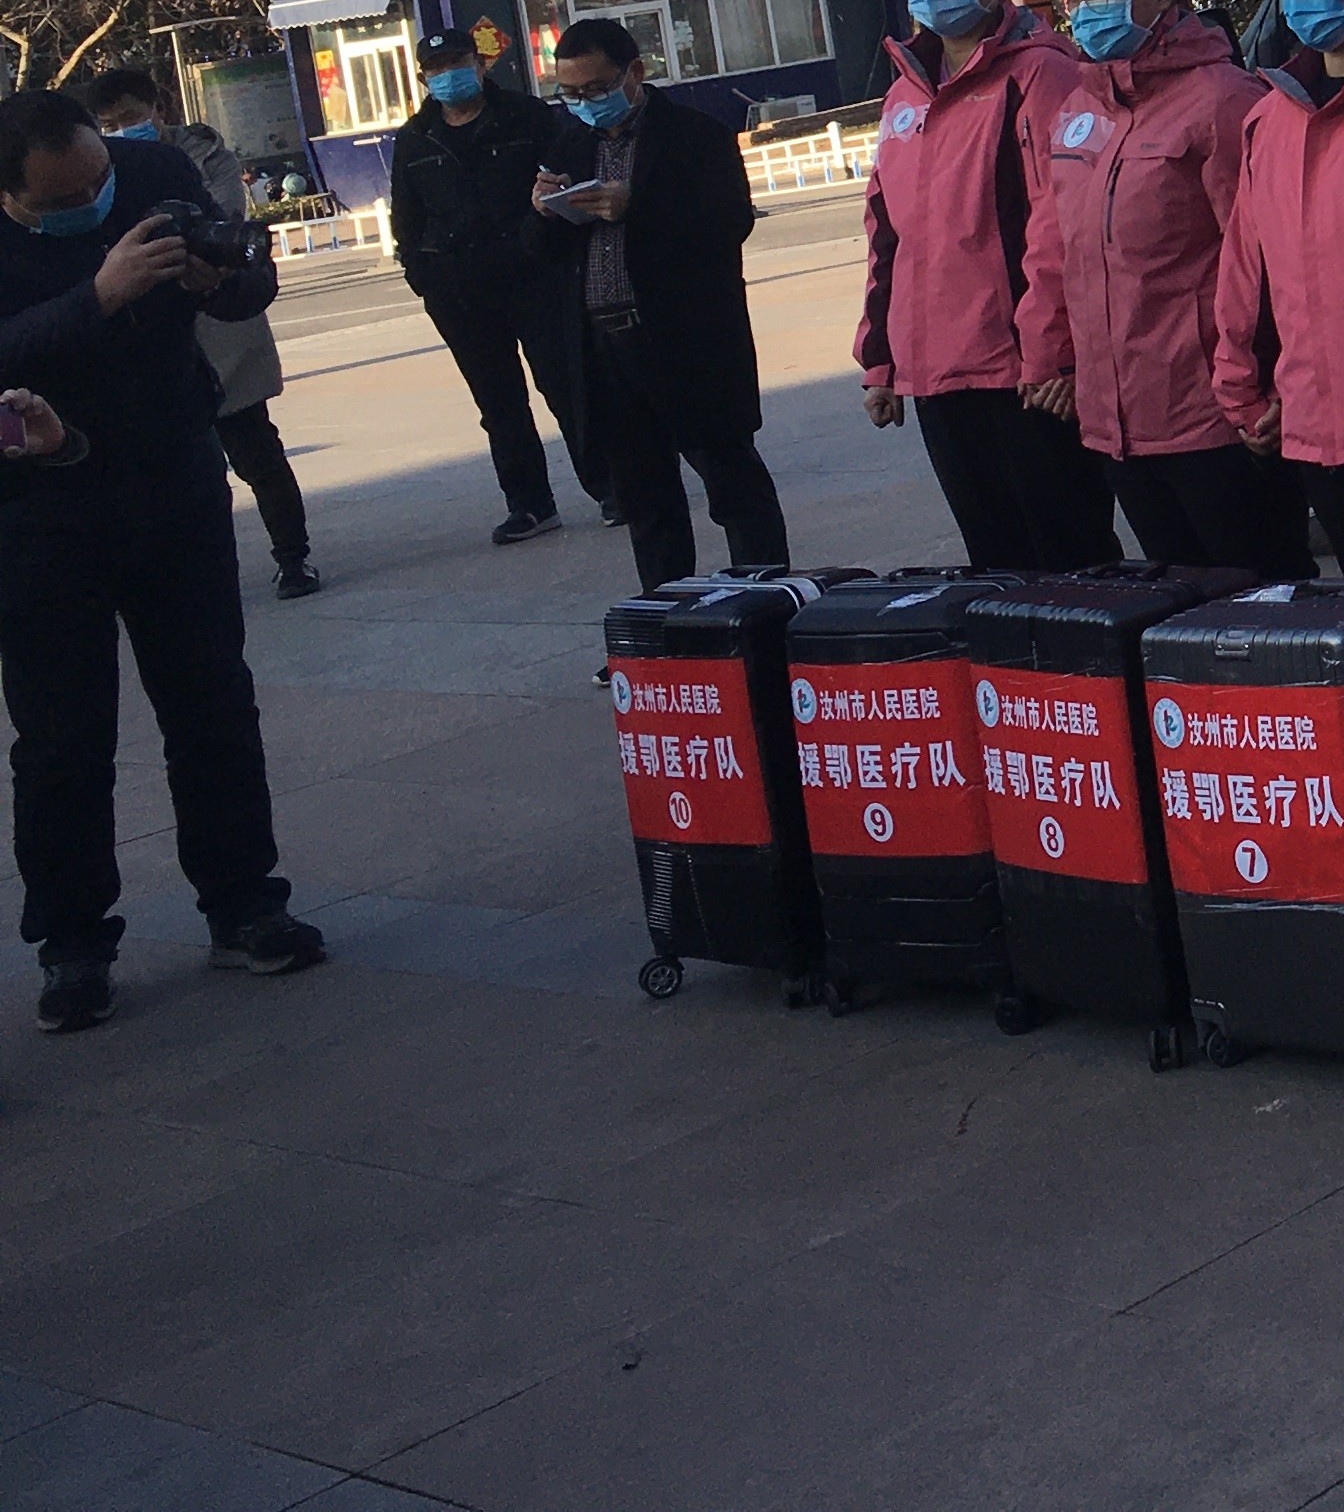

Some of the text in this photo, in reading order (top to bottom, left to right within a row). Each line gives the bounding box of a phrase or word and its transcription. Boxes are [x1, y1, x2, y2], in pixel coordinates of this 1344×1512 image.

[632, 683, 722, 715] 汝州市人民医院
[819, 686, 941, 722] 汝州市人民医院
[1001, 694, 1100, 737] 汝州市人民医院
[1187, 712, 1317, 751] 汝州市人民医院
[618, 730, 744, 780] 援鄂医疗队
[797, 740, 967, 790] 援鄂医疗队
[983, 744, 1121, 810] 援鄂医疗队
[1161, 767, 1344, 828] 援鄂医疗队
